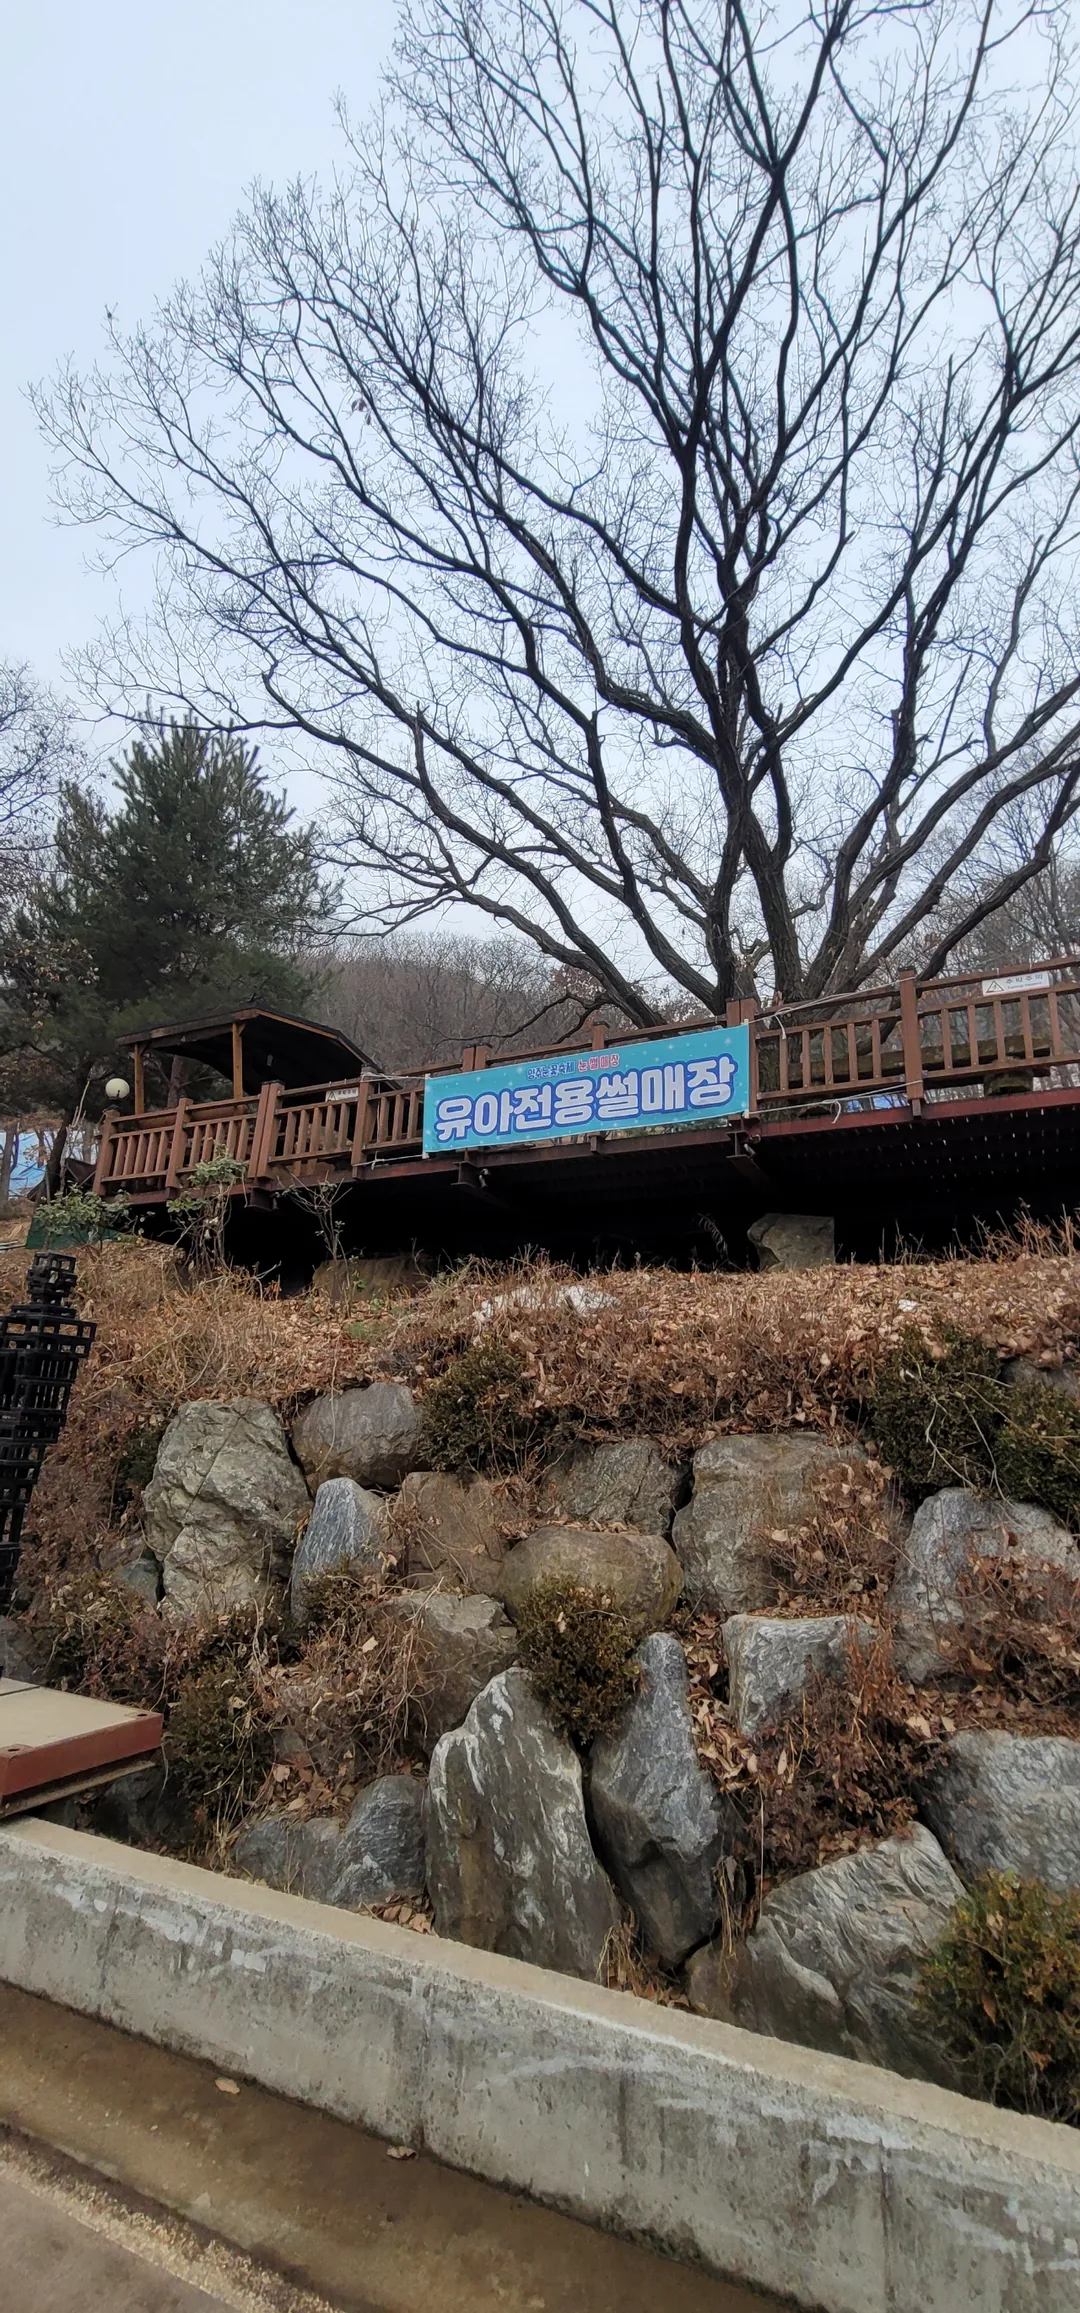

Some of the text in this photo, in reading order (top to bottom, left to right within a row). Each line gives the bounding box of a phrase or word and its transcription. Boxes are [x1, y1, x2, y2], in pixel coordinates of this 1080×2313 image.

[527, 1053, 619, 1080] 양주눈꽃축제 눈썰매장
[436, 1055, 737, 1143] 유아전용썰매장
